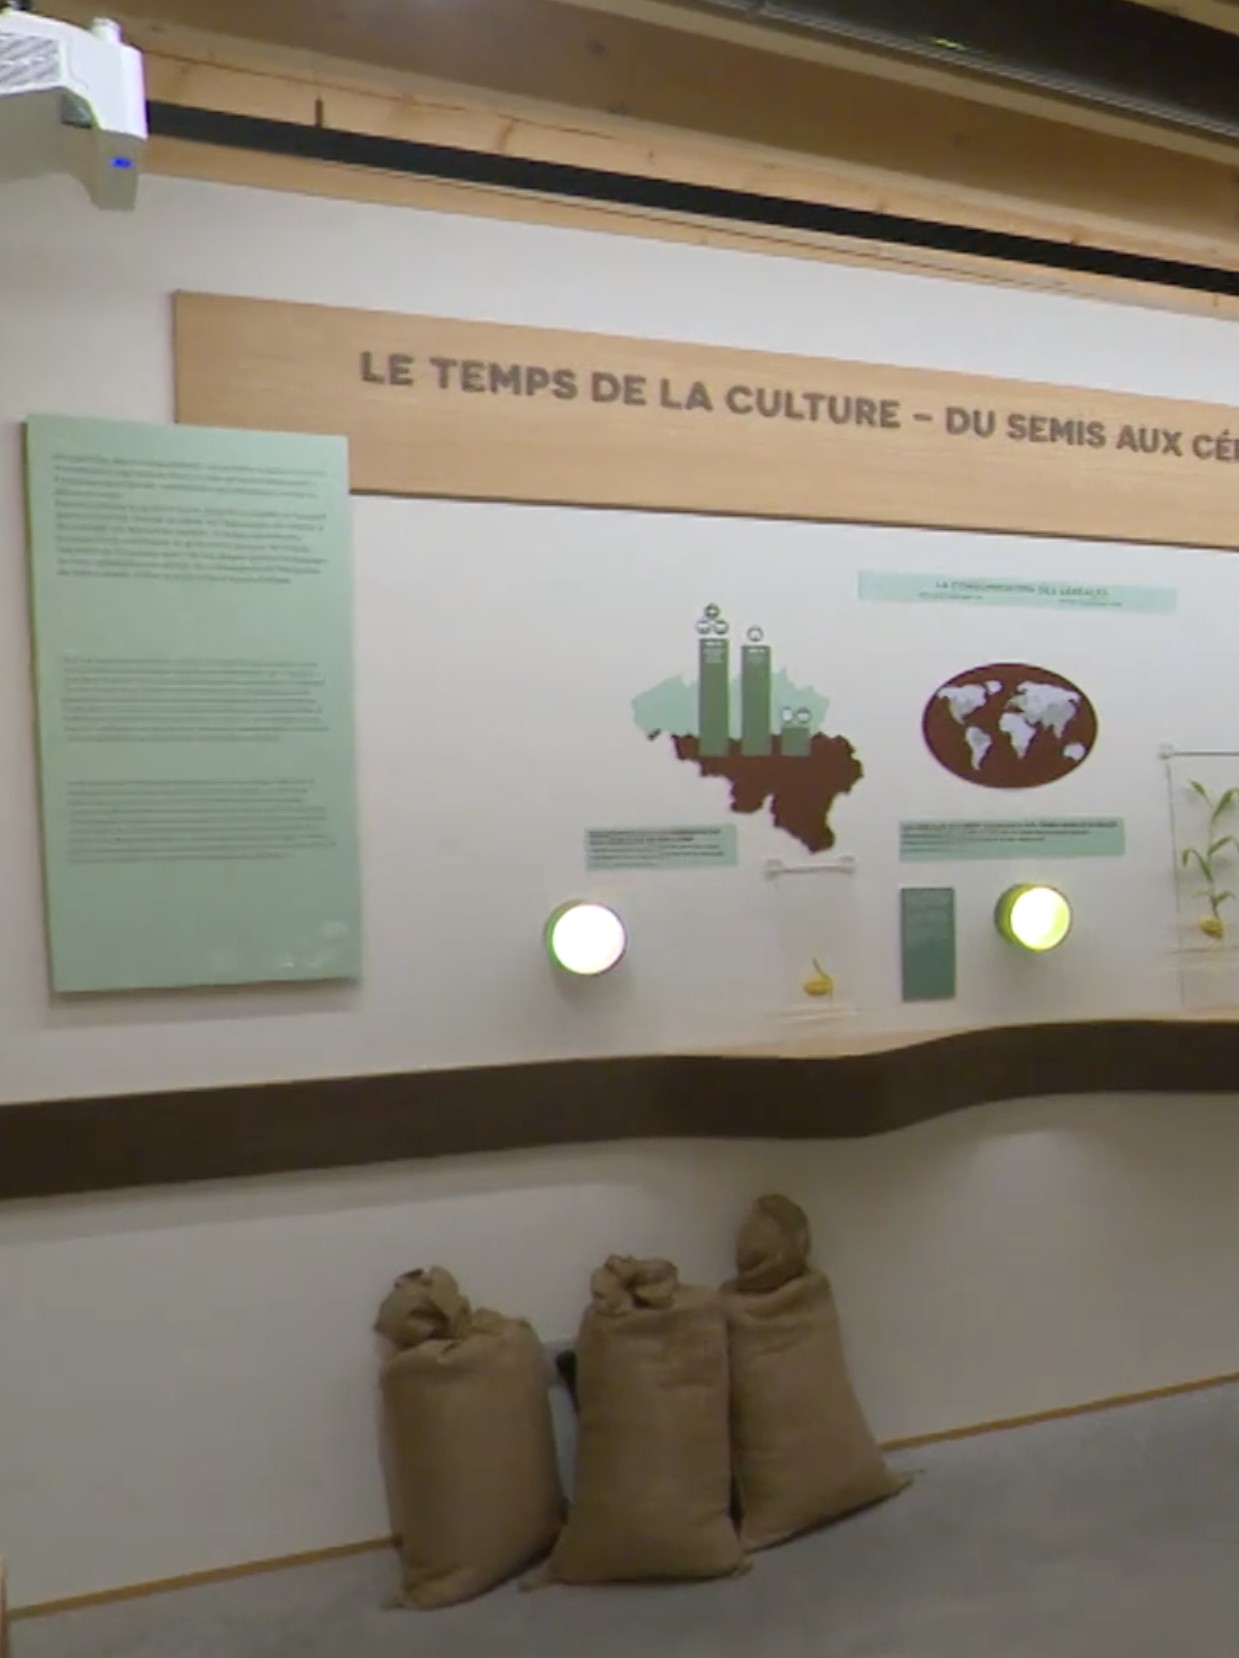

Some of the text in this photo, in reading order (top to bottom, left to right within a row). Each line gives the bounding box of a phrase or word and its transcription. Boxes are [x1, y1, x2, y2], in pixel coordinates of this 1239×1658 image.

[360, 351, 414, 387] LE
[429, 357, 579, 400] TEMPS
[591, 371, 647, 407] DE
[660, 378, 714, 412] LA
[724, 385, 901, 430] CULTURE
[945, 406, 996, 439] DU
[1006, 413, 1107, 449] SEMIS
[1115, 424, 1184, 458] AUX
